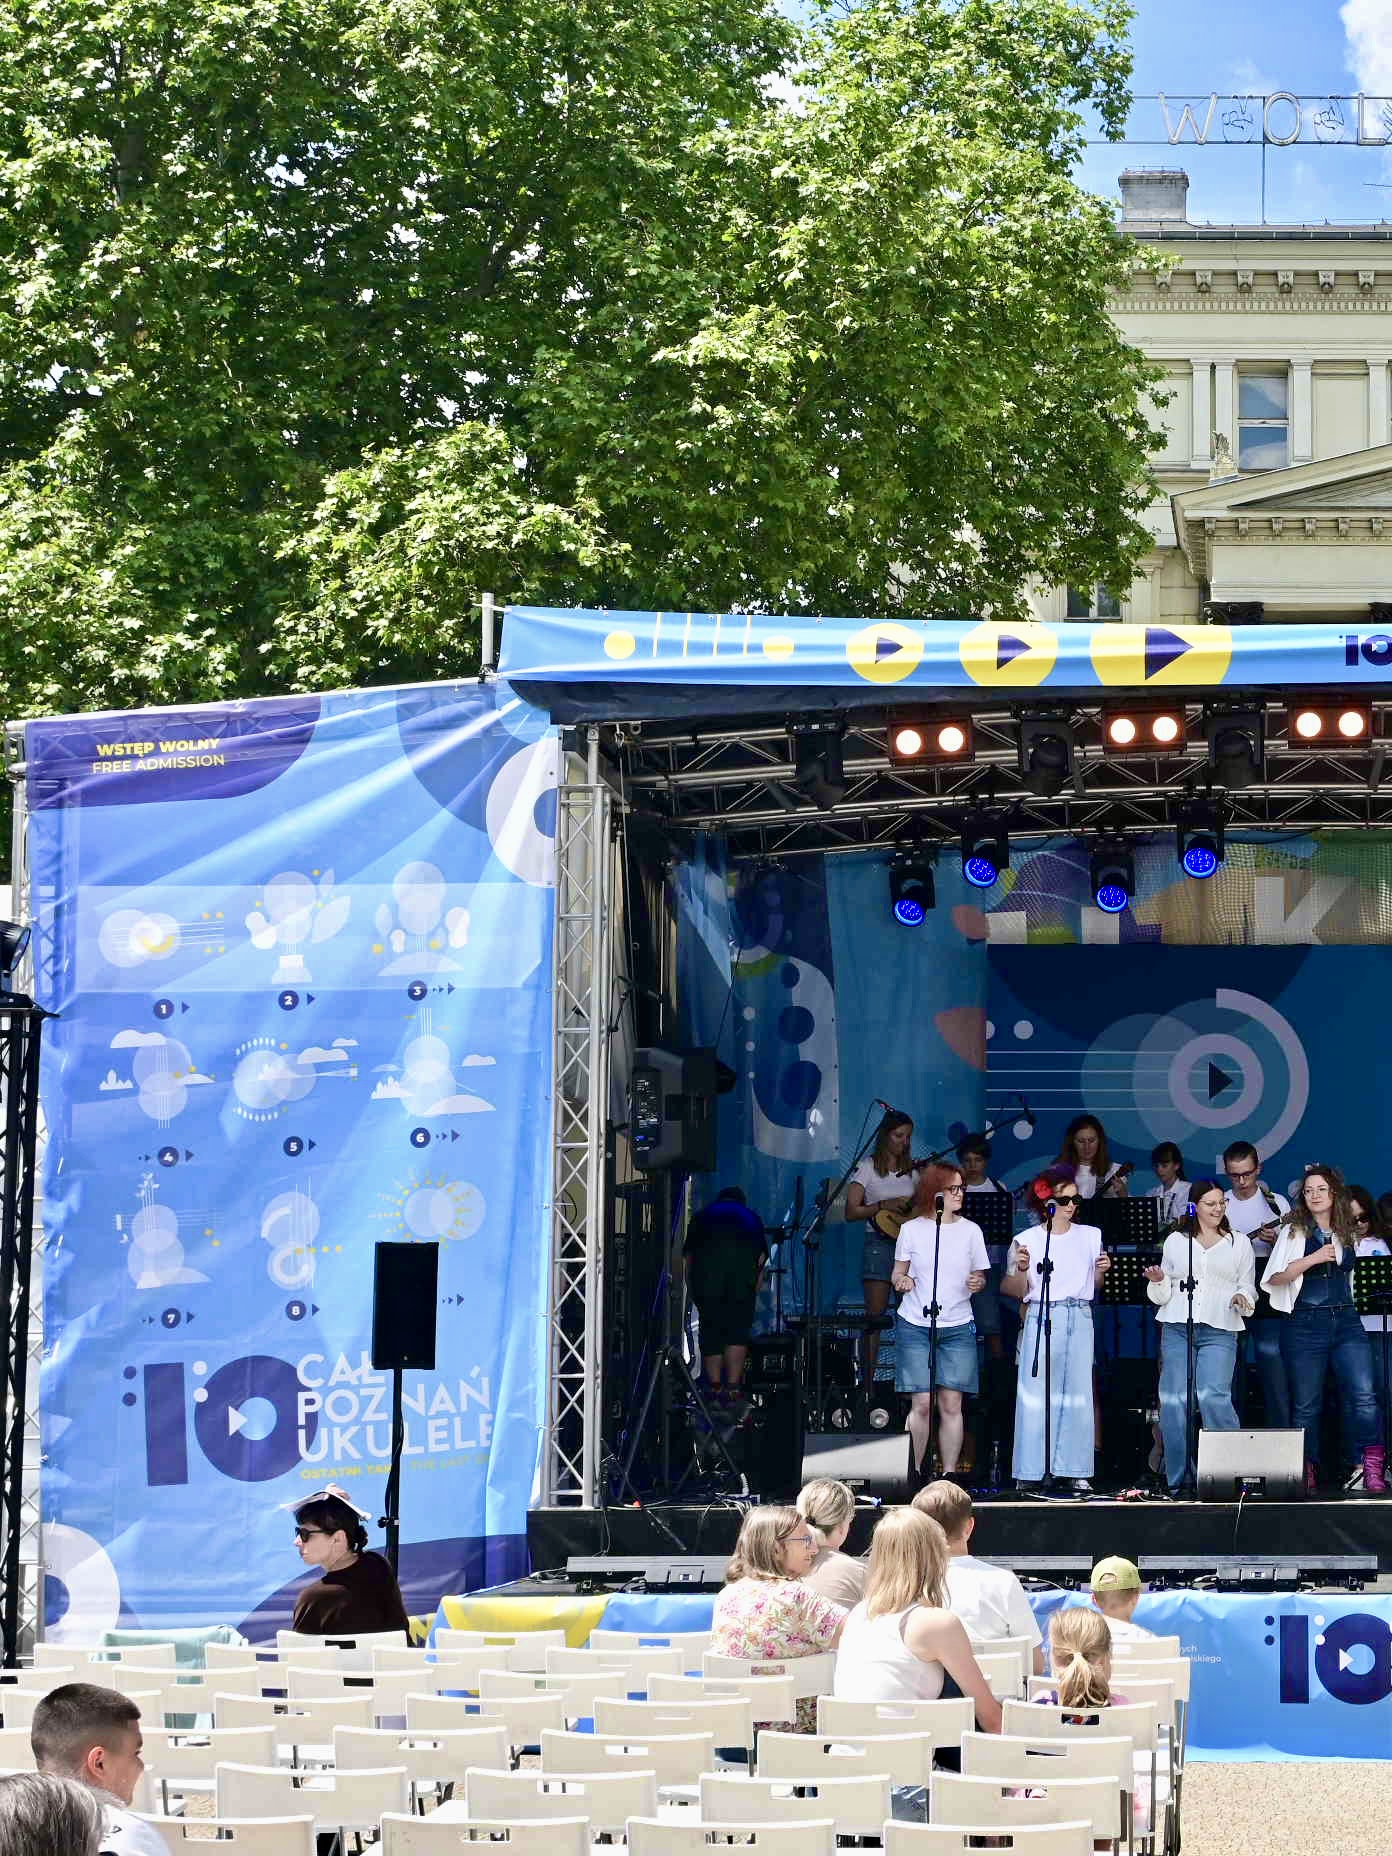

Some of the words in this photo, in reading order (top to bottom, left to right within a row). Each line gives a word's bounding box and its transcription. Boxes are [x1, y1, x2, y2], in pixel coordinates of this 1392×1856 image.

[92, 760, 132, 774] FREE
[135, 754, 225, 771] ADMISSION
[96, 742, 155, 757] WSTĘP
[159, 738, 220, 753] WOLNY
[296, 1350, 386, 1388] CAŁ
[297, 1365, 491, 1424] POZNAŃ
[297, 1413, 493, 1463] UKULELE
